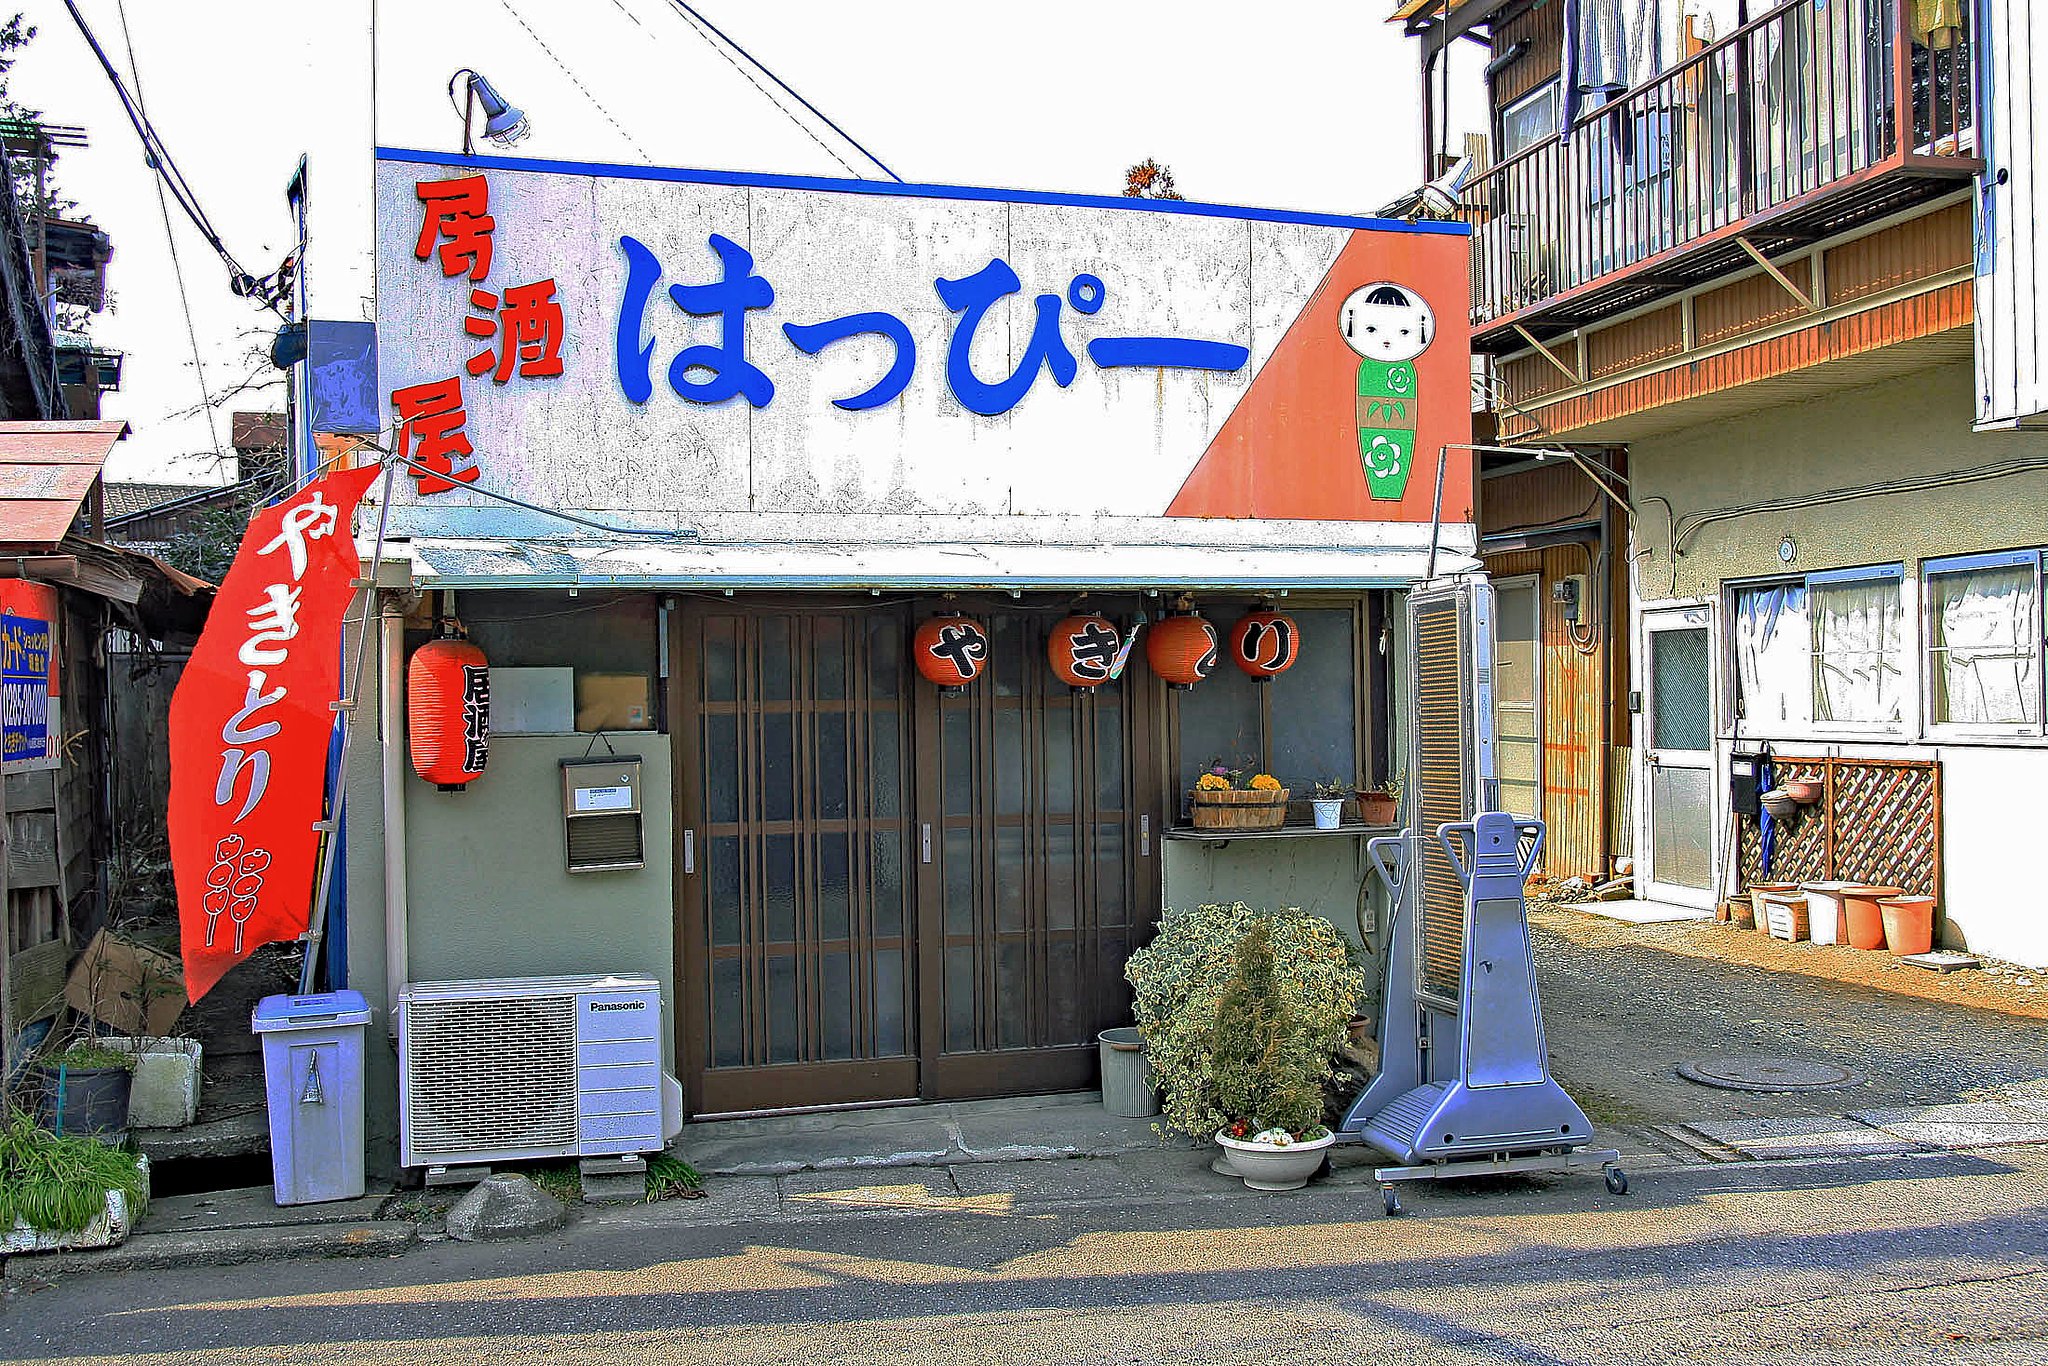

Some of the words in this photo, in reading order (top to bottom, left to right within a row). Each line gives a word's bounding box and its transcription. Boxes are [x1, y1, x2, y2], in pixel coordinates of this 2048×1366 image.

[392, 174, 564, 495] 居酒屋
[616, 233, 1249, 416] はっぴー
[215, 491, 338, 825] やきとり
[590, 999, 646, 1012] Panasonic
